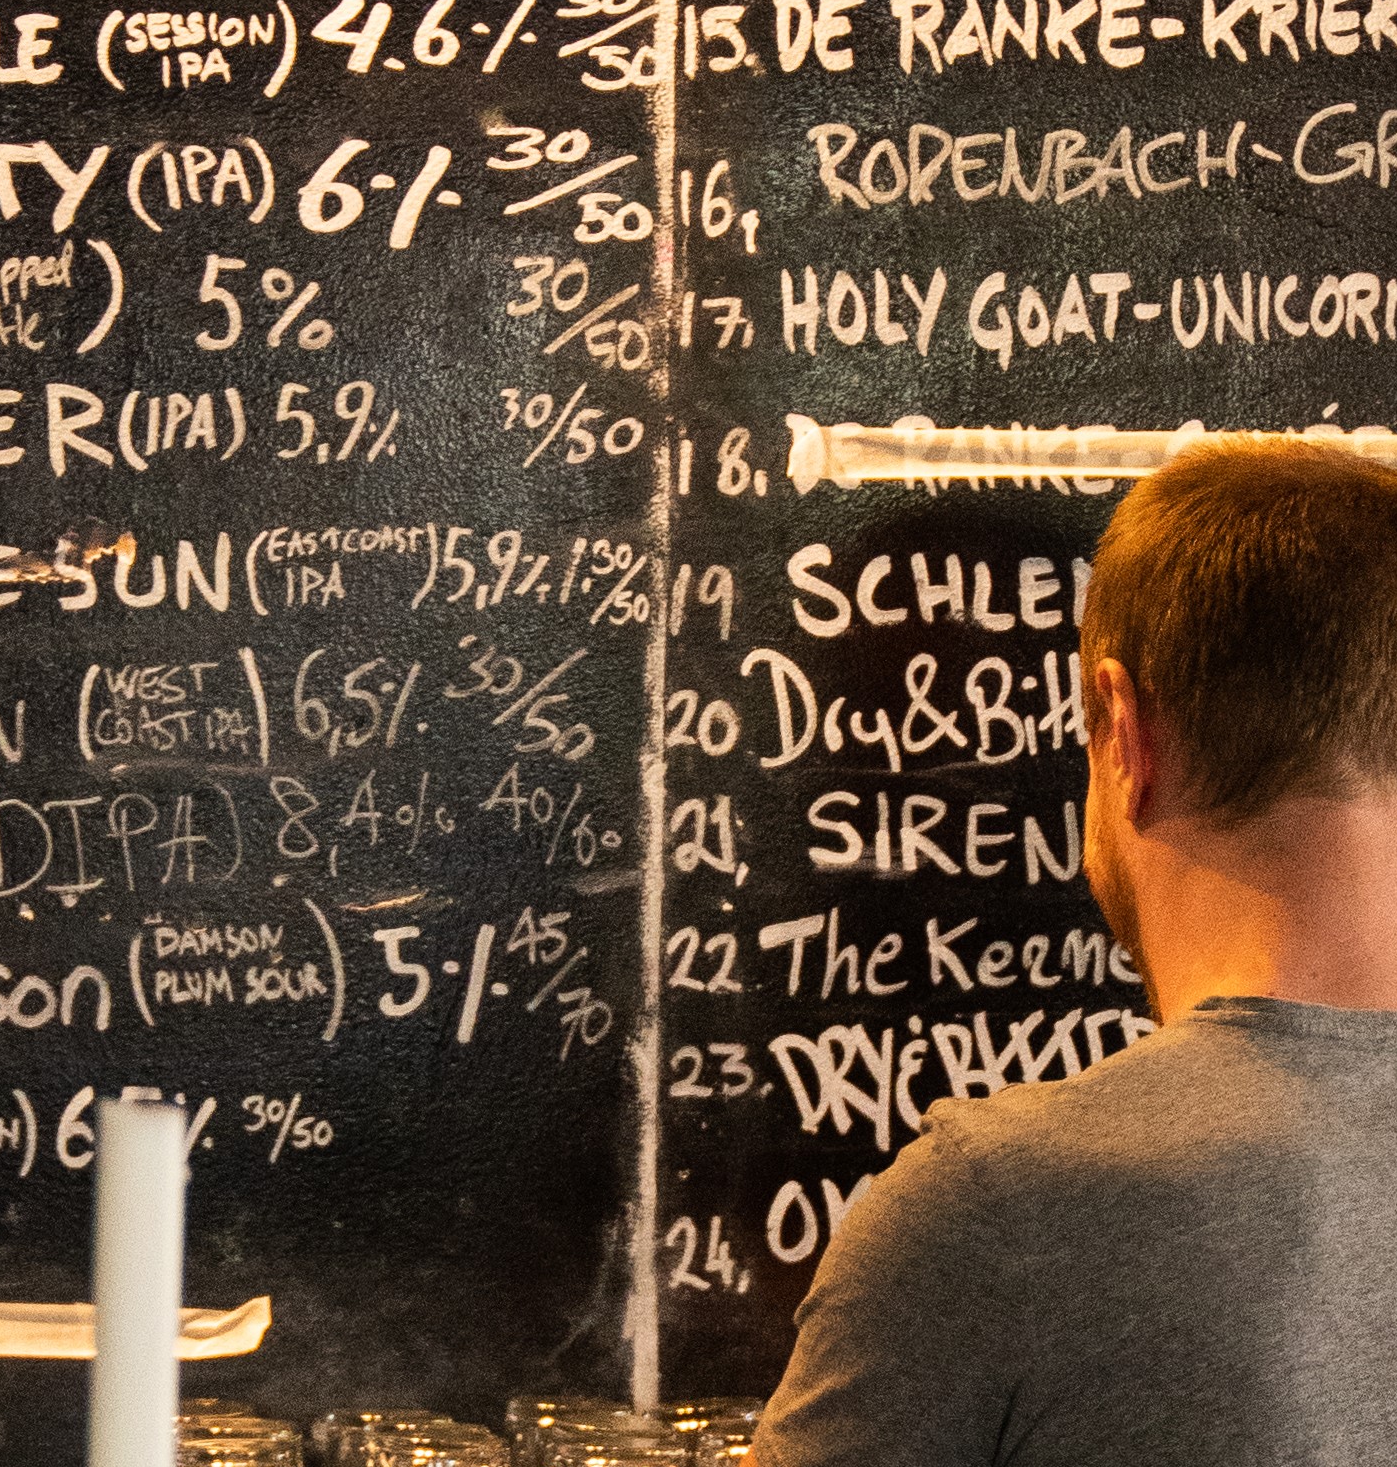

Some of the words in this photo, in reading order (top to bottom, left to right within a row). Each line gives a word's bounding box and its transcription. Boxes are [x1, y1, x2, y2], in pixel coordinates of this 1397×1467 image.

[125, 9, 280, 53] SESSION
[161, 50, 232, 88] IPA
[197, 255, 333, 350] 5%
[780, 266, 946, 356] HOLY
[759, 907, 910, 1000] The
